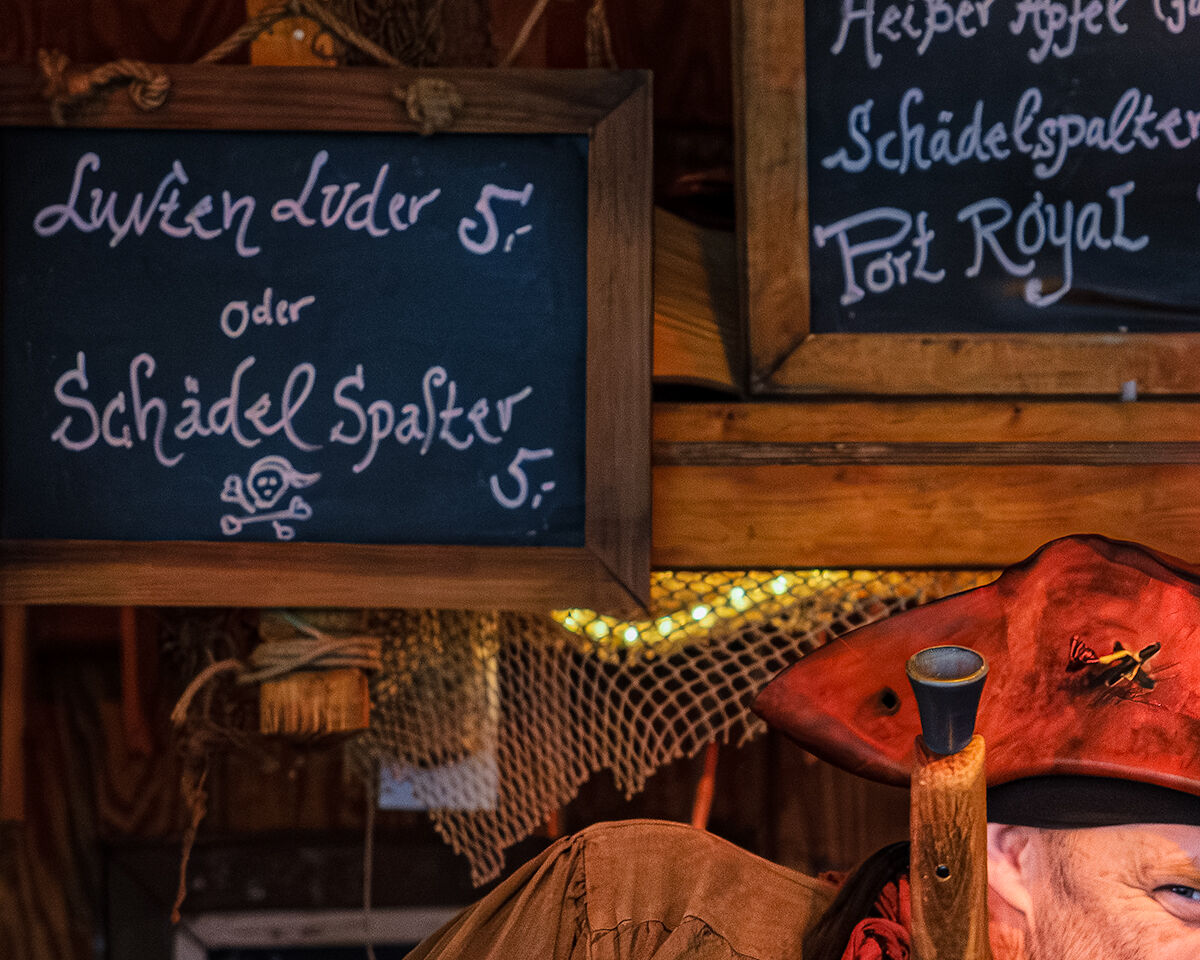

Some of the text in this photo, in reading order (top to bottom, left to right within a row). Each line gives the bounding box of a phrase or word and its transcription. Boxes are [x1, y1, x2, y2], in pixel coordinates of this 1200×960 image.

[457, 182, 534, 255] 5,-
[51, 351, 325, 468] Schädel
[490, 447, 556, 509] 5,-
